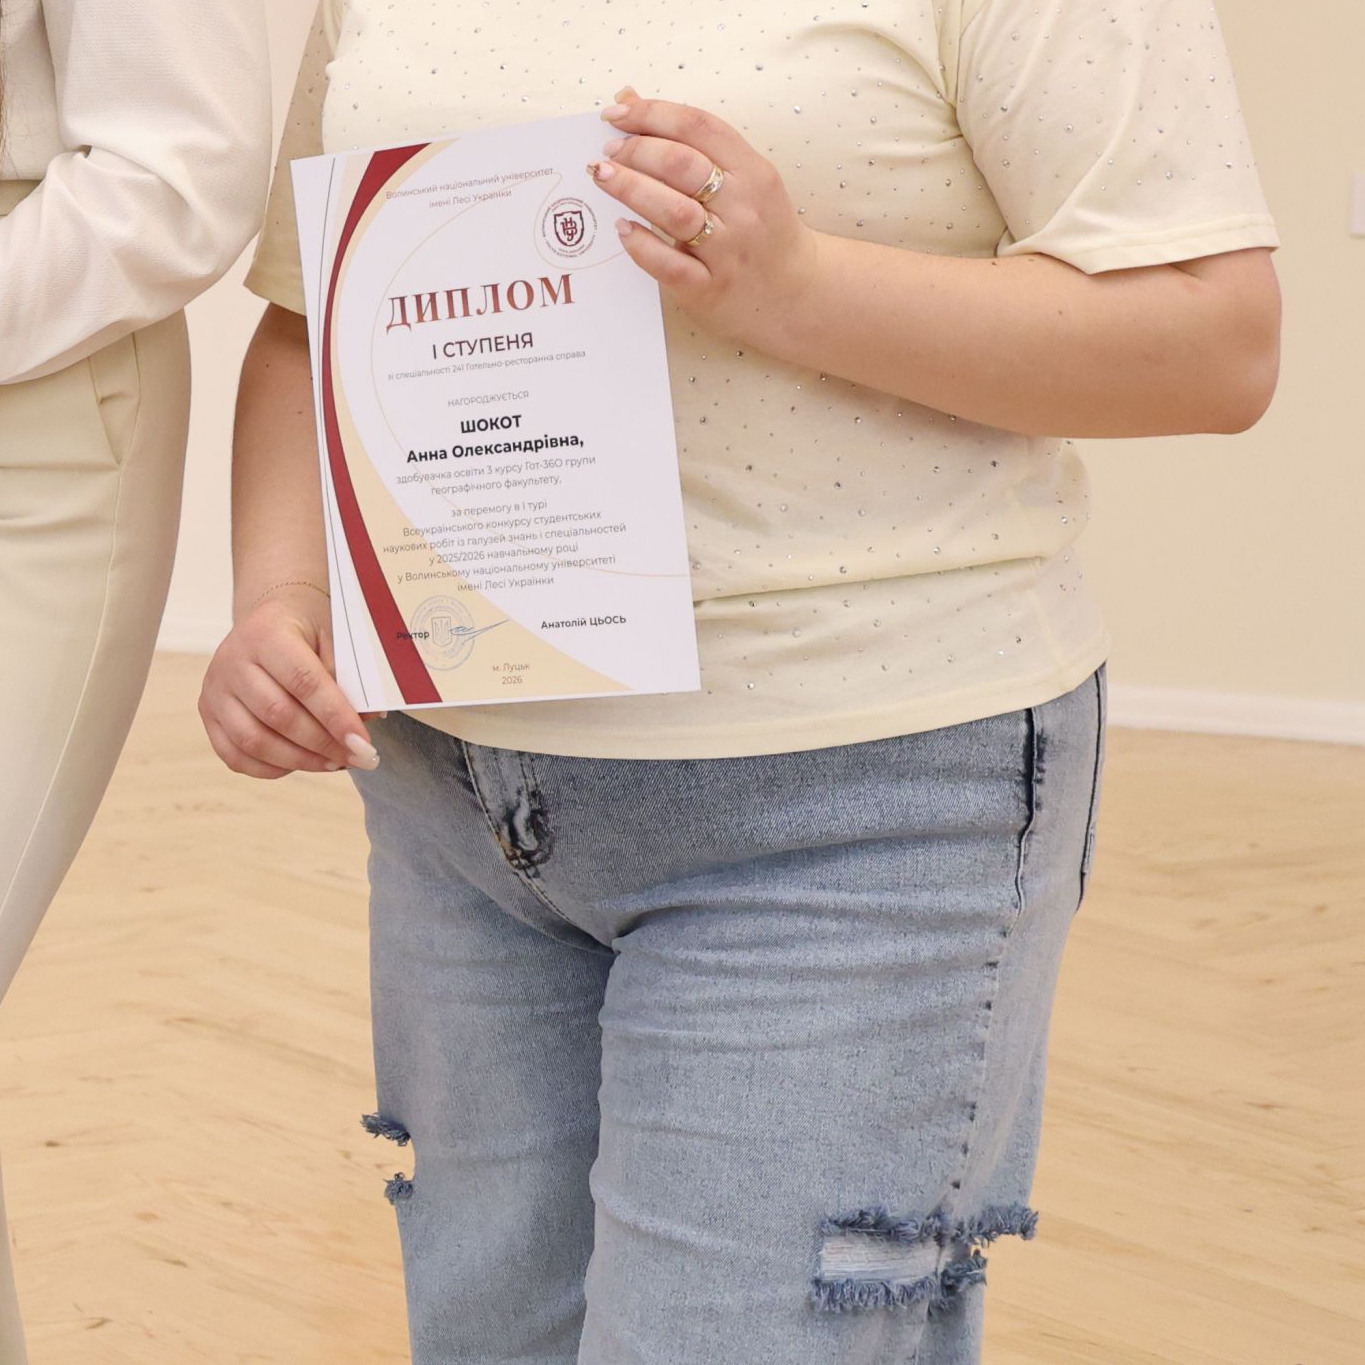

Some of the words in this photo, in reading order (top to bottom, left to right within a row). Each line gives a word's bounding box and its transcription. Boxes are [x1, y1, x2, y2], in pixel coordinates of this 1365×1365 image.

[386, 273, 575, 334] ДИПЛОМ
[441, 331, 534, 358] СТУПЕНЯ
[446, 389, 529, 407] НАГОРОДЖУЄТЬСЯ
[459, 413, 522, 434] ШОКОТ
[404, 448, 449, 464] Анна
[451, 433, 583, 459] Олександрівна,
[393, 470, 452, 485] здобувачка
[453, 466, 485, 478] освіти
[494, 463, 524, 476] курсу
[563, 455, 594, 468] групи
[429, 480, 503, 495] географічного
[462, 503, 512, 517] перемогу
[526, 497, 547, 512] турі
[401, 521, 485, 538] Всеукраїнського
[485, 517, 532, 529] конкурсу
[533, 510, 600, 526] студентських
[455, 579, 482, 592] імені
[483, 577, 506, 590] Лесі
[506, 575, 554, 589] Українки
[539, 616, 587, 630] Анатолій
[588, 614, 627, 627] ЦЬОСЬ
